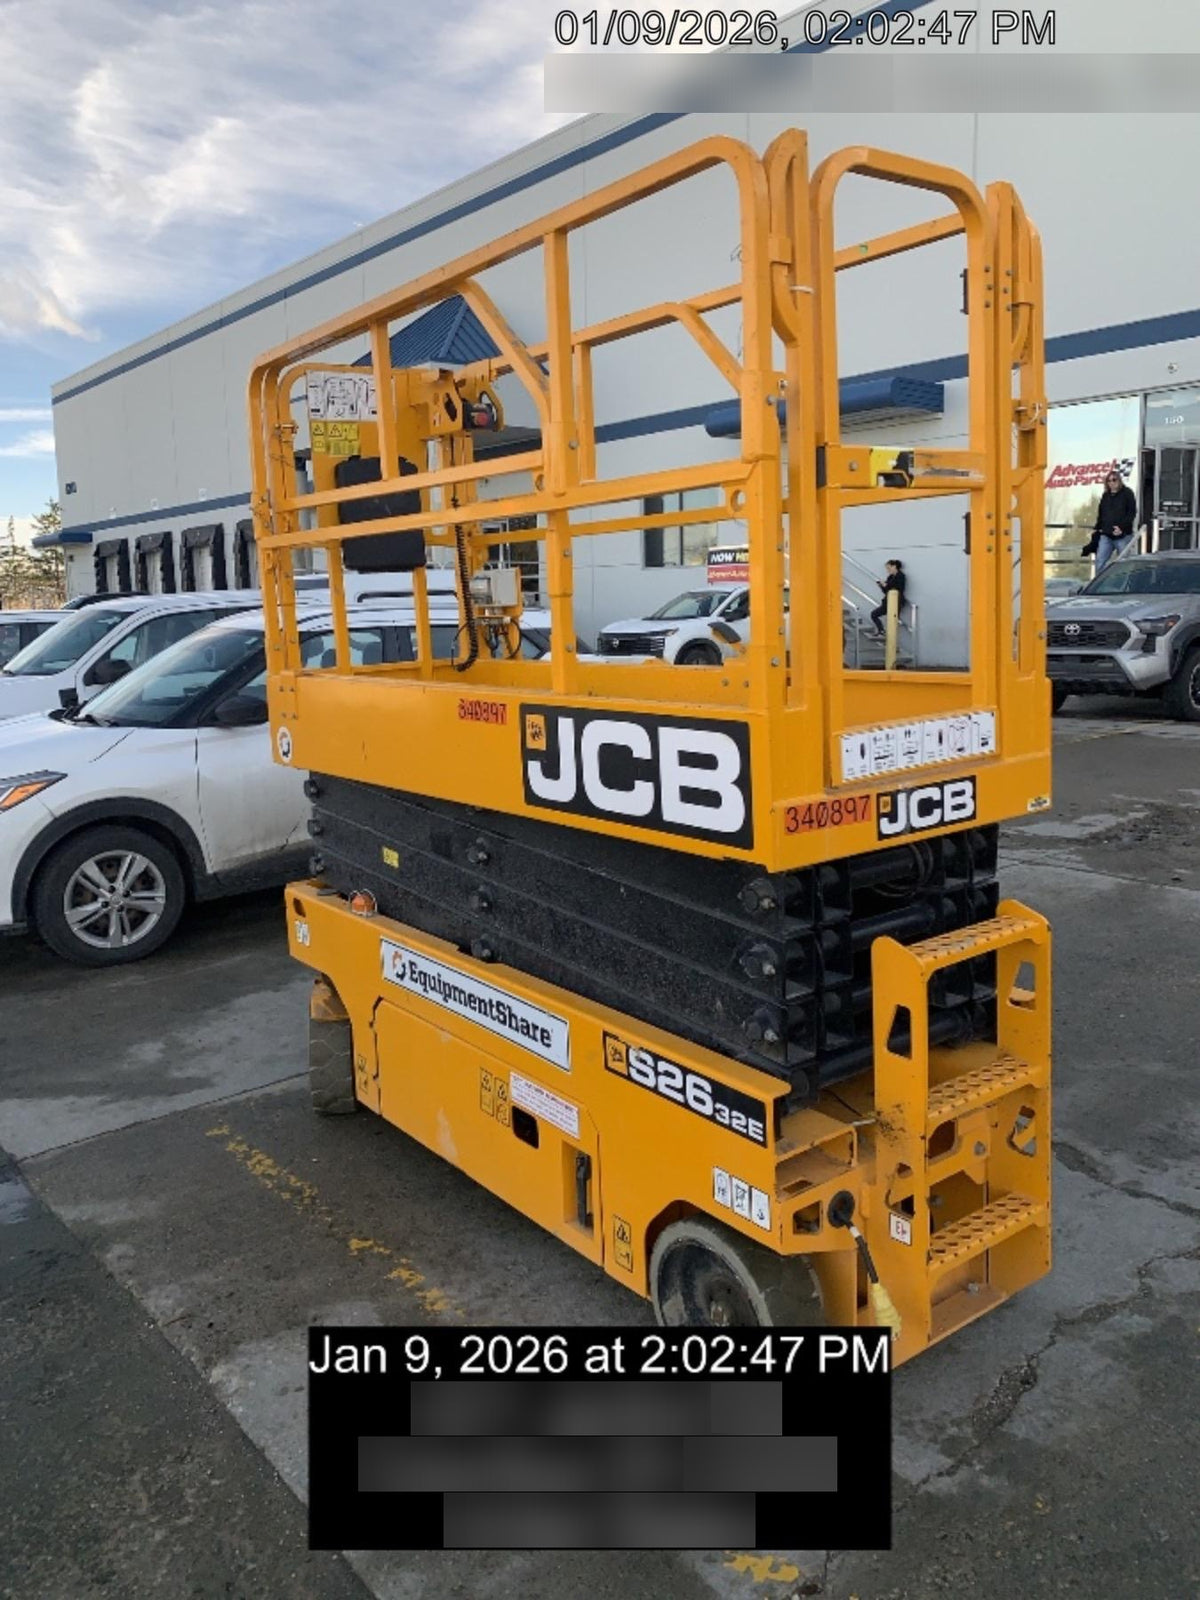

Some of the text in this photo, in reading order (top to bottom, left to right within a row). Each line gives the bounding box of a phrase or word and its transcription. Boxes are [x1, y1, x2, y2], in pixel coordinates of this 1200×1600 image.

[710, 552, 735, 563] NOW
[527, 716, 746, 834] JCB
[786, 795, 871, 833] 340897
[880, 781, 974, 835] JCB
[408, 959, 553, 1049] EquipmentShare
